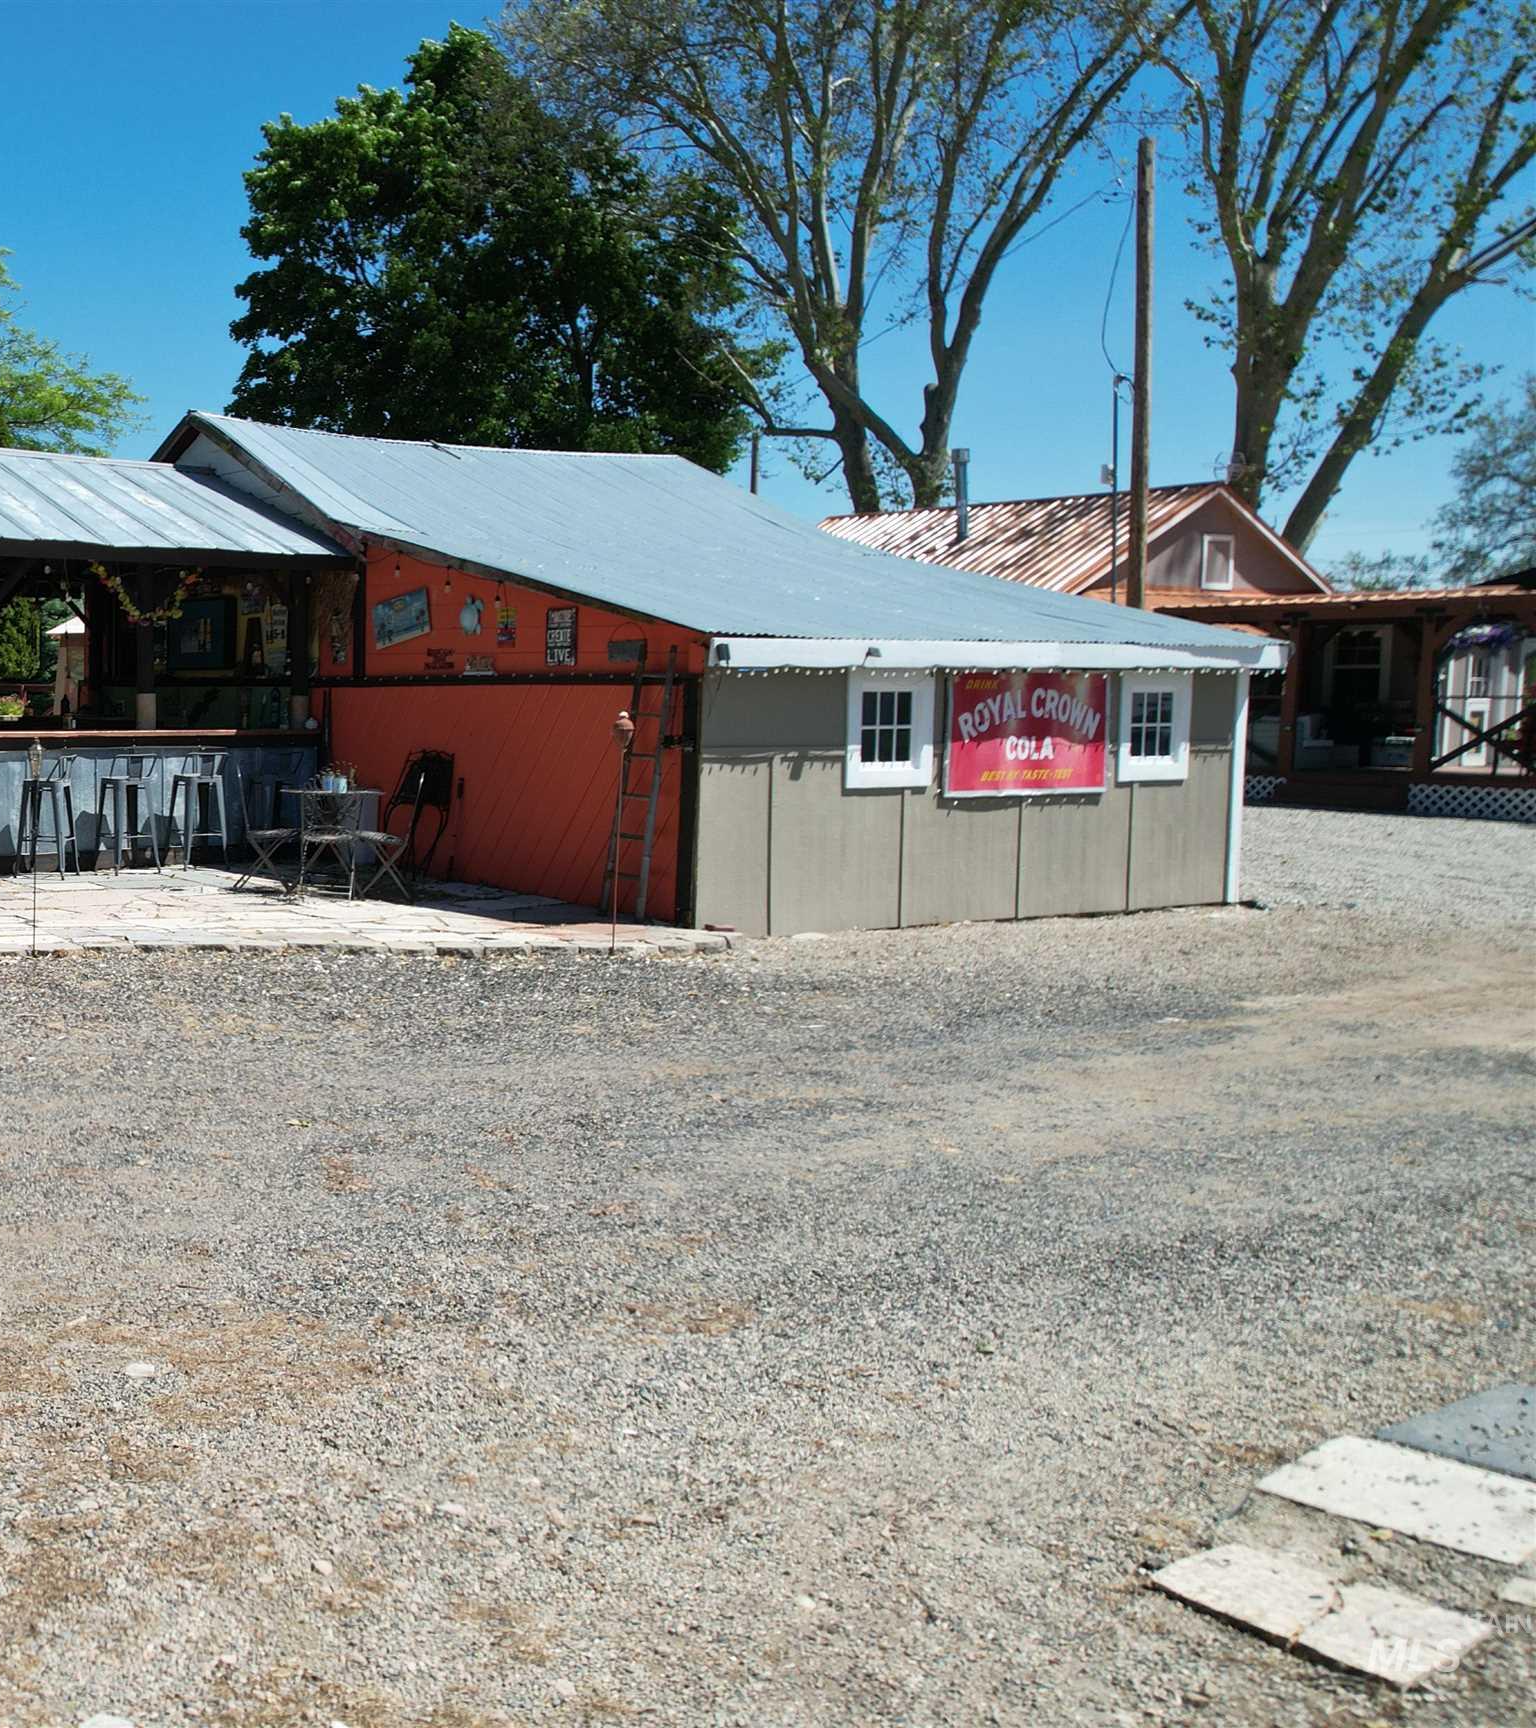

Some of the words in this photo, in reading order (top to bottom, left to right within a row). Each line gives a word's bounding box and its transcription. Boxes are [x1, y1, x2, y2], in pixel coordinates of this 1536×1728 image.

[966, 679, 1000, 689] DRINK
[958, 688, 1026, 741] ROYAL
[1031, 687, 1101, 740] CROWN
[1005, 735, 1055, 760] COLA
